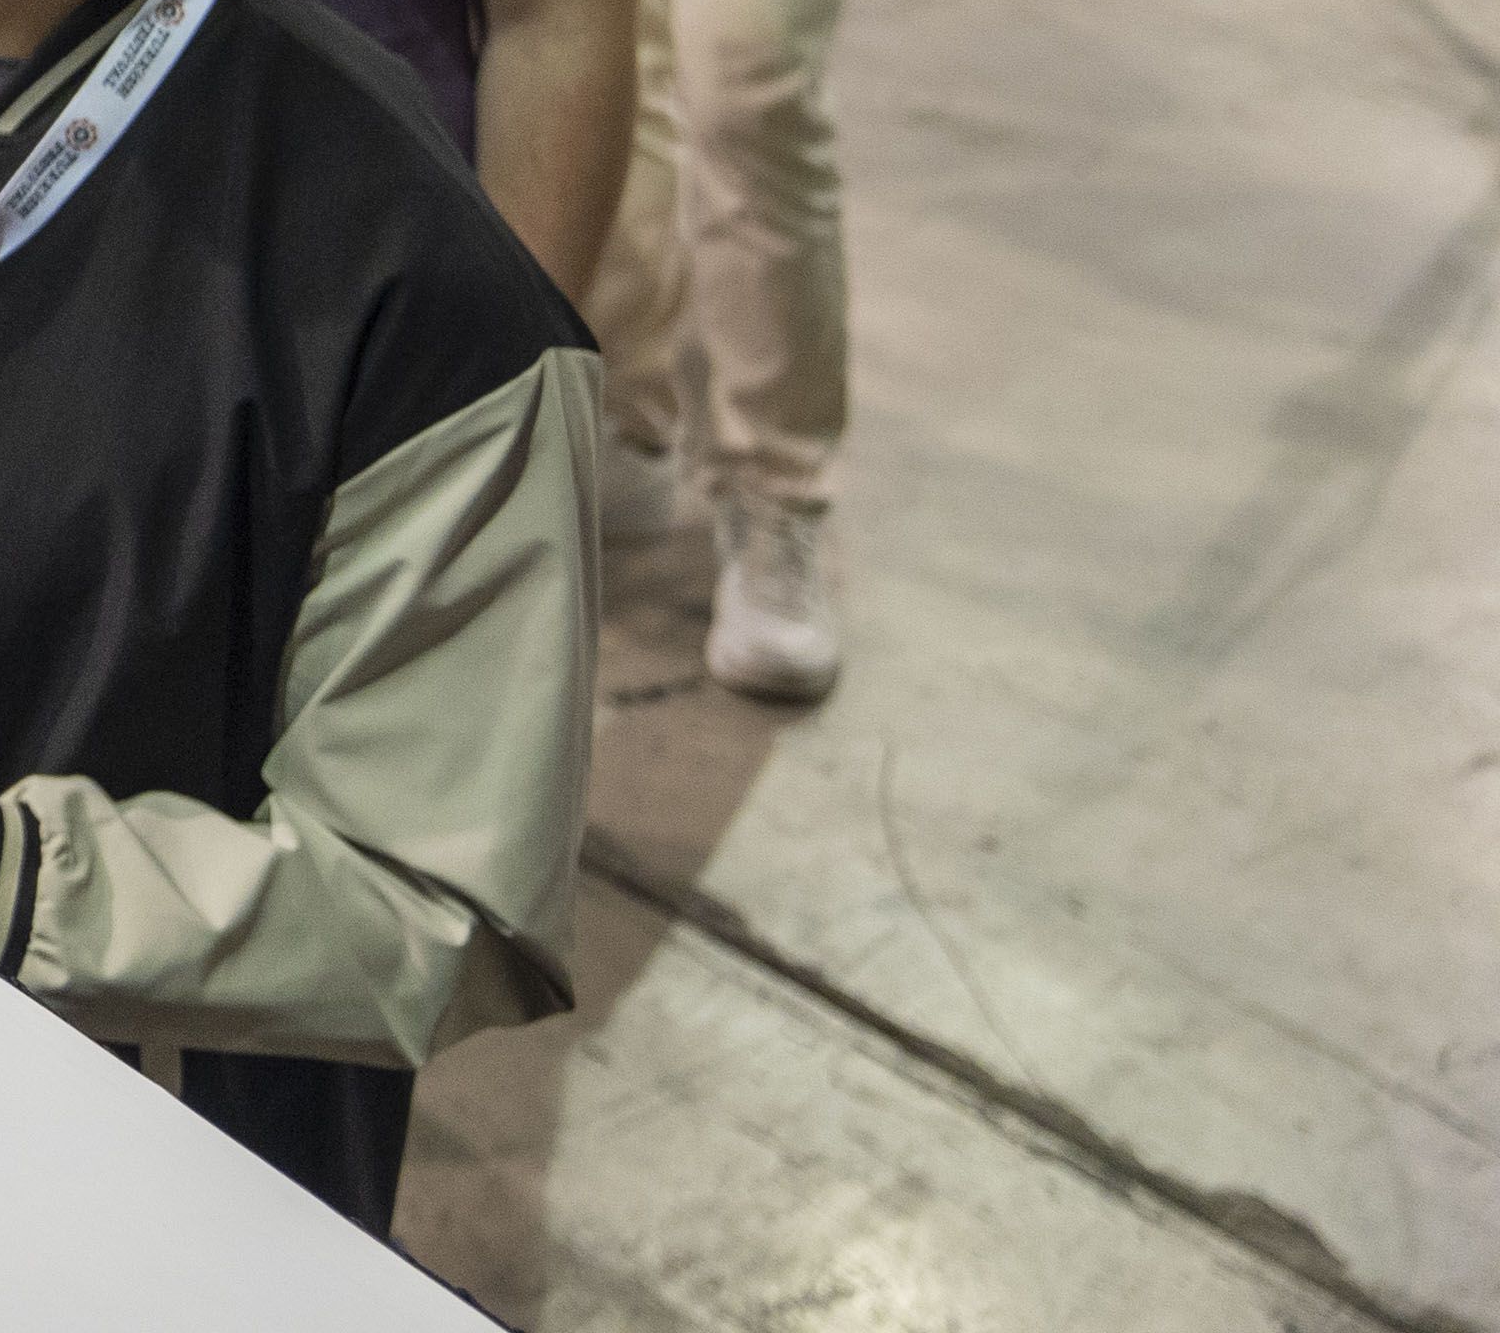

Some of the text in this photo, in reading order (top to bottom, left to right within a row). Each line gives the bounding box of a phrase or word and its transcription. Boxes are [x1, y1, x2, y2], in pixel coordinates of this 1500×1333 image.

[102, 15, 156, 89] FESTIVAL
[117, 29, 171, 100] TURKISH
[5, 140, 65, 210] FESTIVAL
[19, 151, 78, 220] TURKISH
